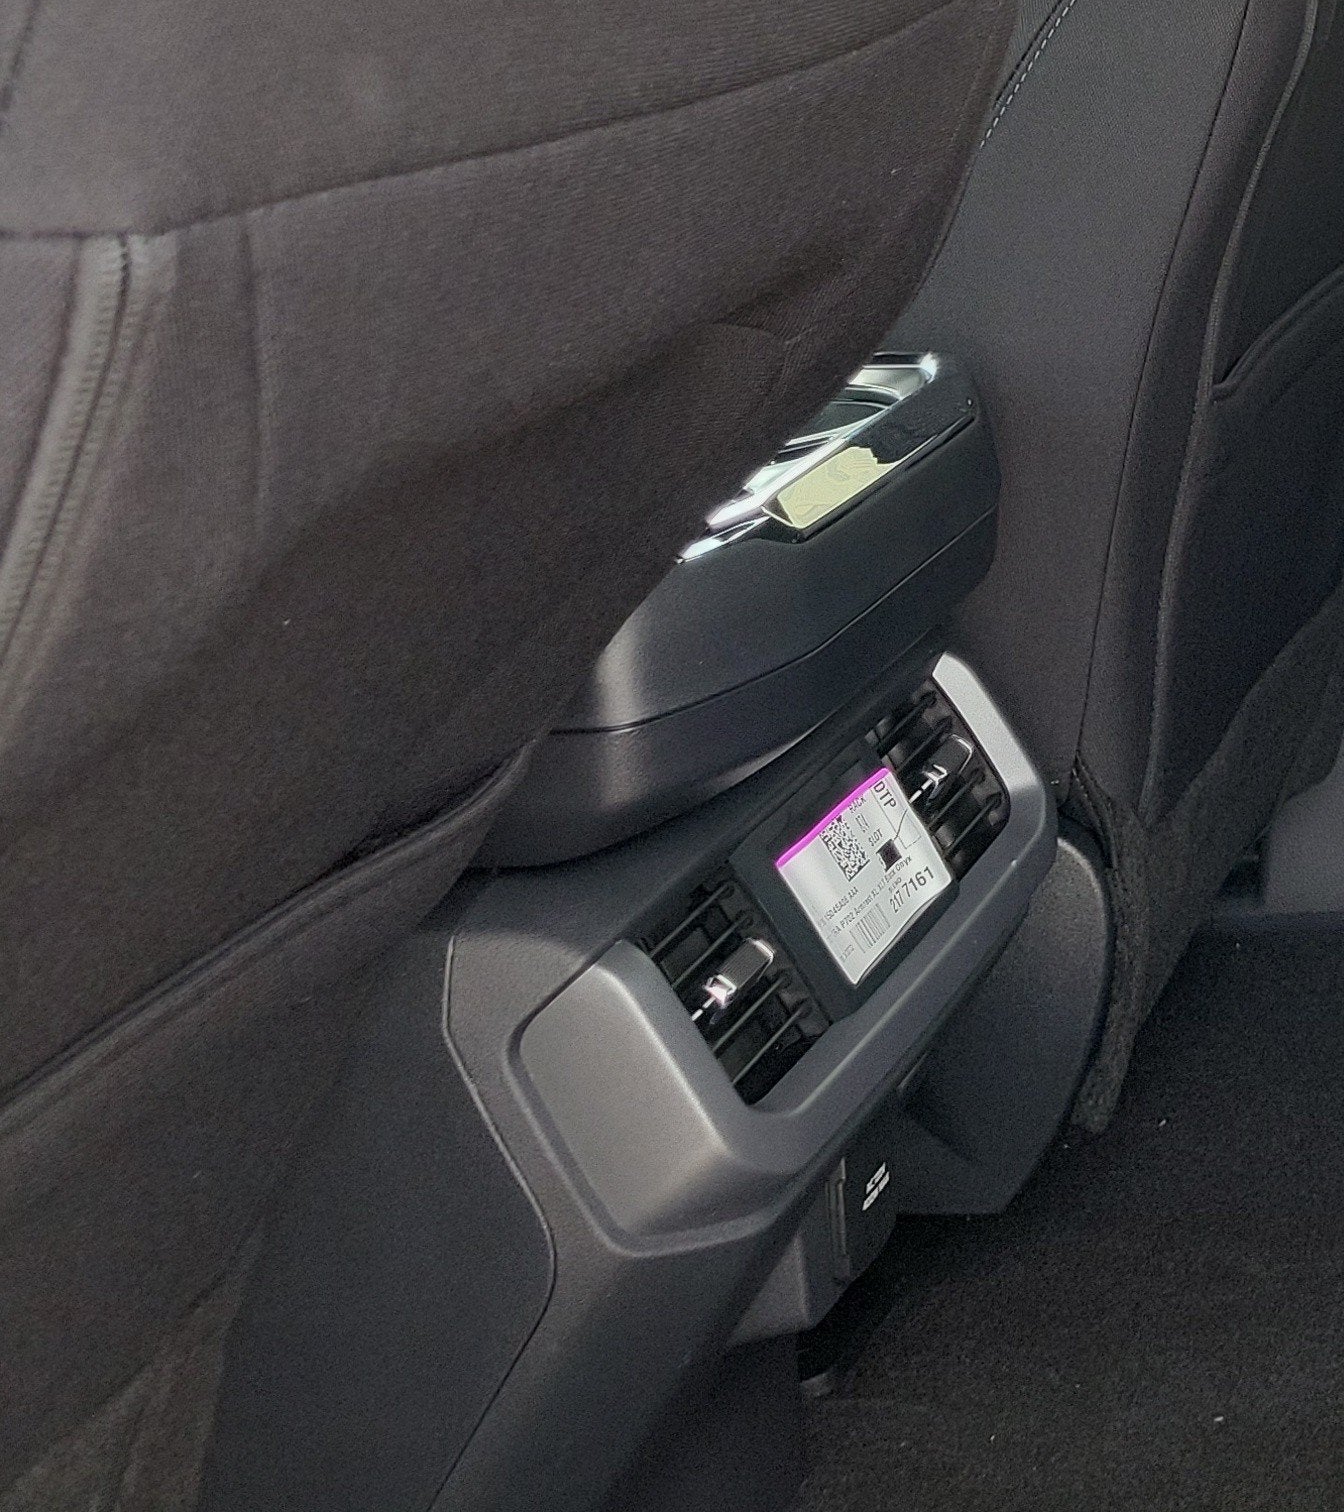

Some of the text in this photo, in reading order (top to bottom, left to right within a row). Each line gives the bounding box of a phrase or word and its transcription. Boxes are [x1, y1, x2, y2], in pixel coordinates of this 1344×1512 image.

[873, 780, 897, 808] DTP
[849, 795, 866, 813] RACK
[868, 829, 883, 846] SLOT
[895, 855, 912, 872] Onyx
